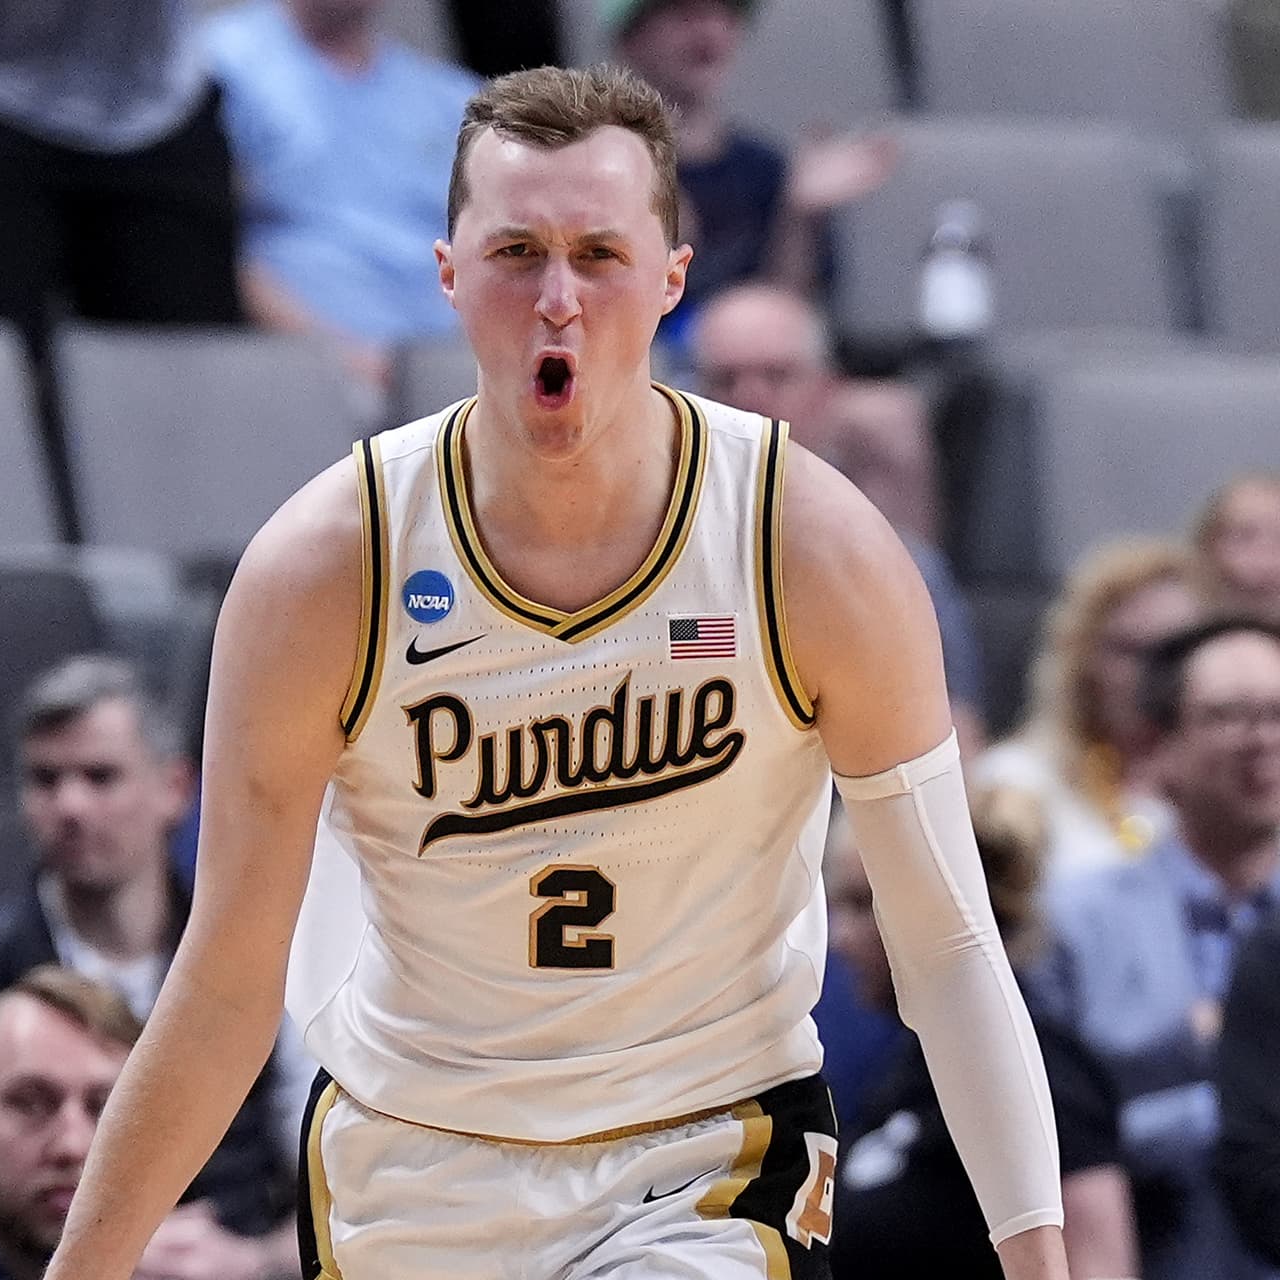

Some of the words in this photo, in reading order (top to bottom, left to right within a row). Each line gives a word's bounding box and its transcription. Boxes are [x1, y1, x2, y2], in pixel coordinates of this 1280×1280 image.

[407, 594, 449, 611] NCAA
[400, 669, 746, 810] Purdue
[528, 864, 617, 970] 2
